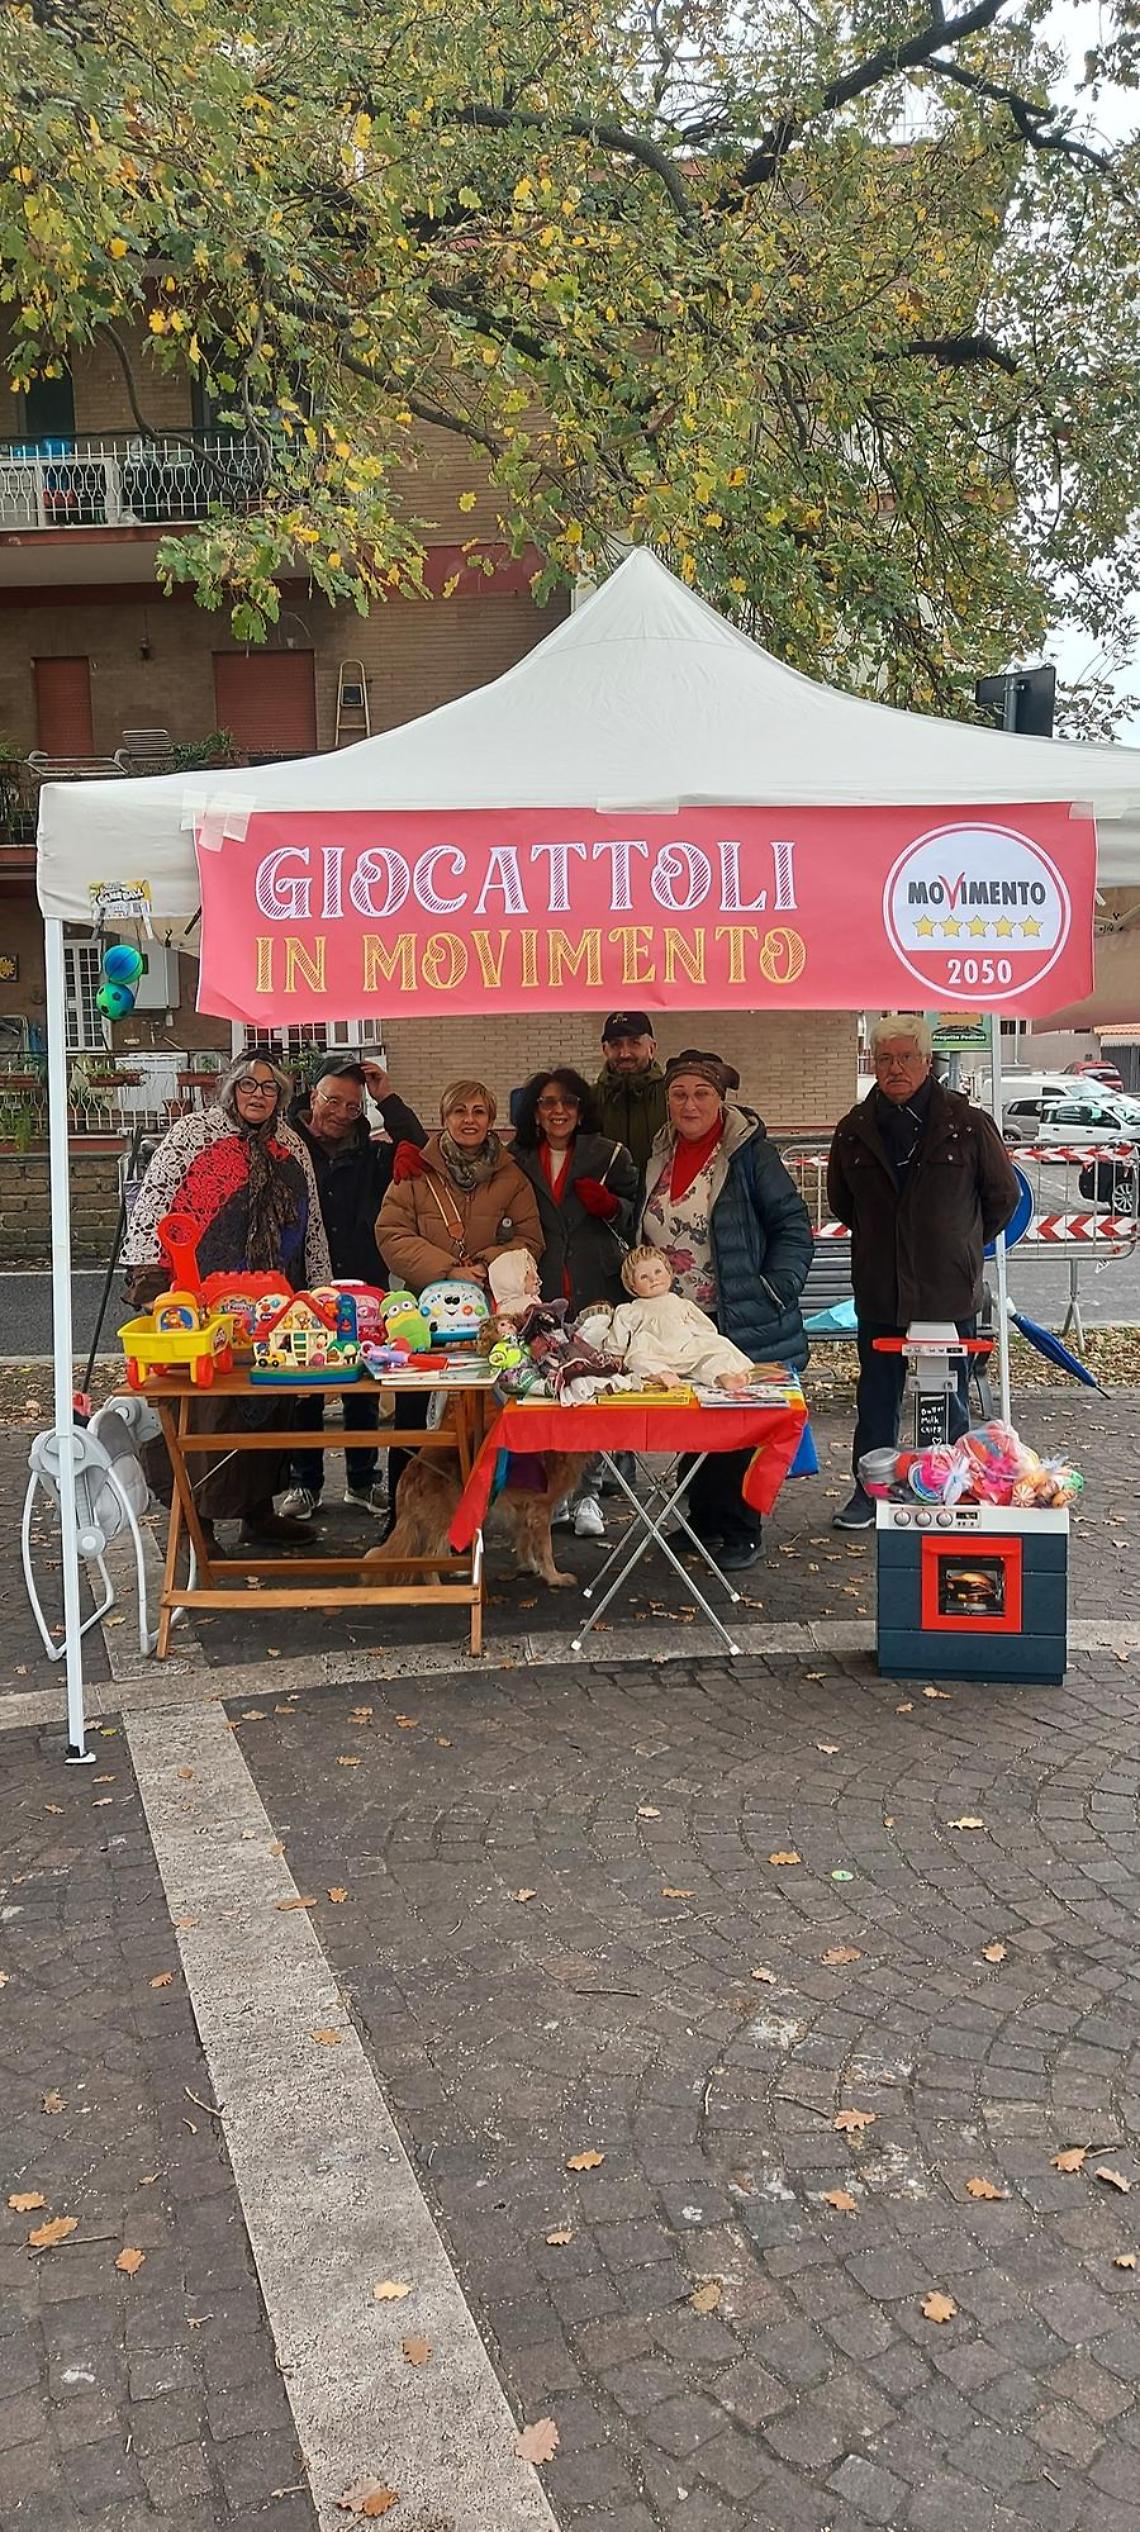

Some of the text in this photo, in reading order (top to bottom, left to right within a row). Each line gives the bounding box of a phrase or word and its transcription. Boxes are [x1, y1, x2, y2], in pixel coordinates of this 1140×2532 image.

[255, 840, 799, 920] GIOCATTOLI
[907, 871, 1046, 911] MOVIMENTO
[255, 925, 808, 993] IN MOVIMENTO
[946, 958, 1013, 985] 2050
